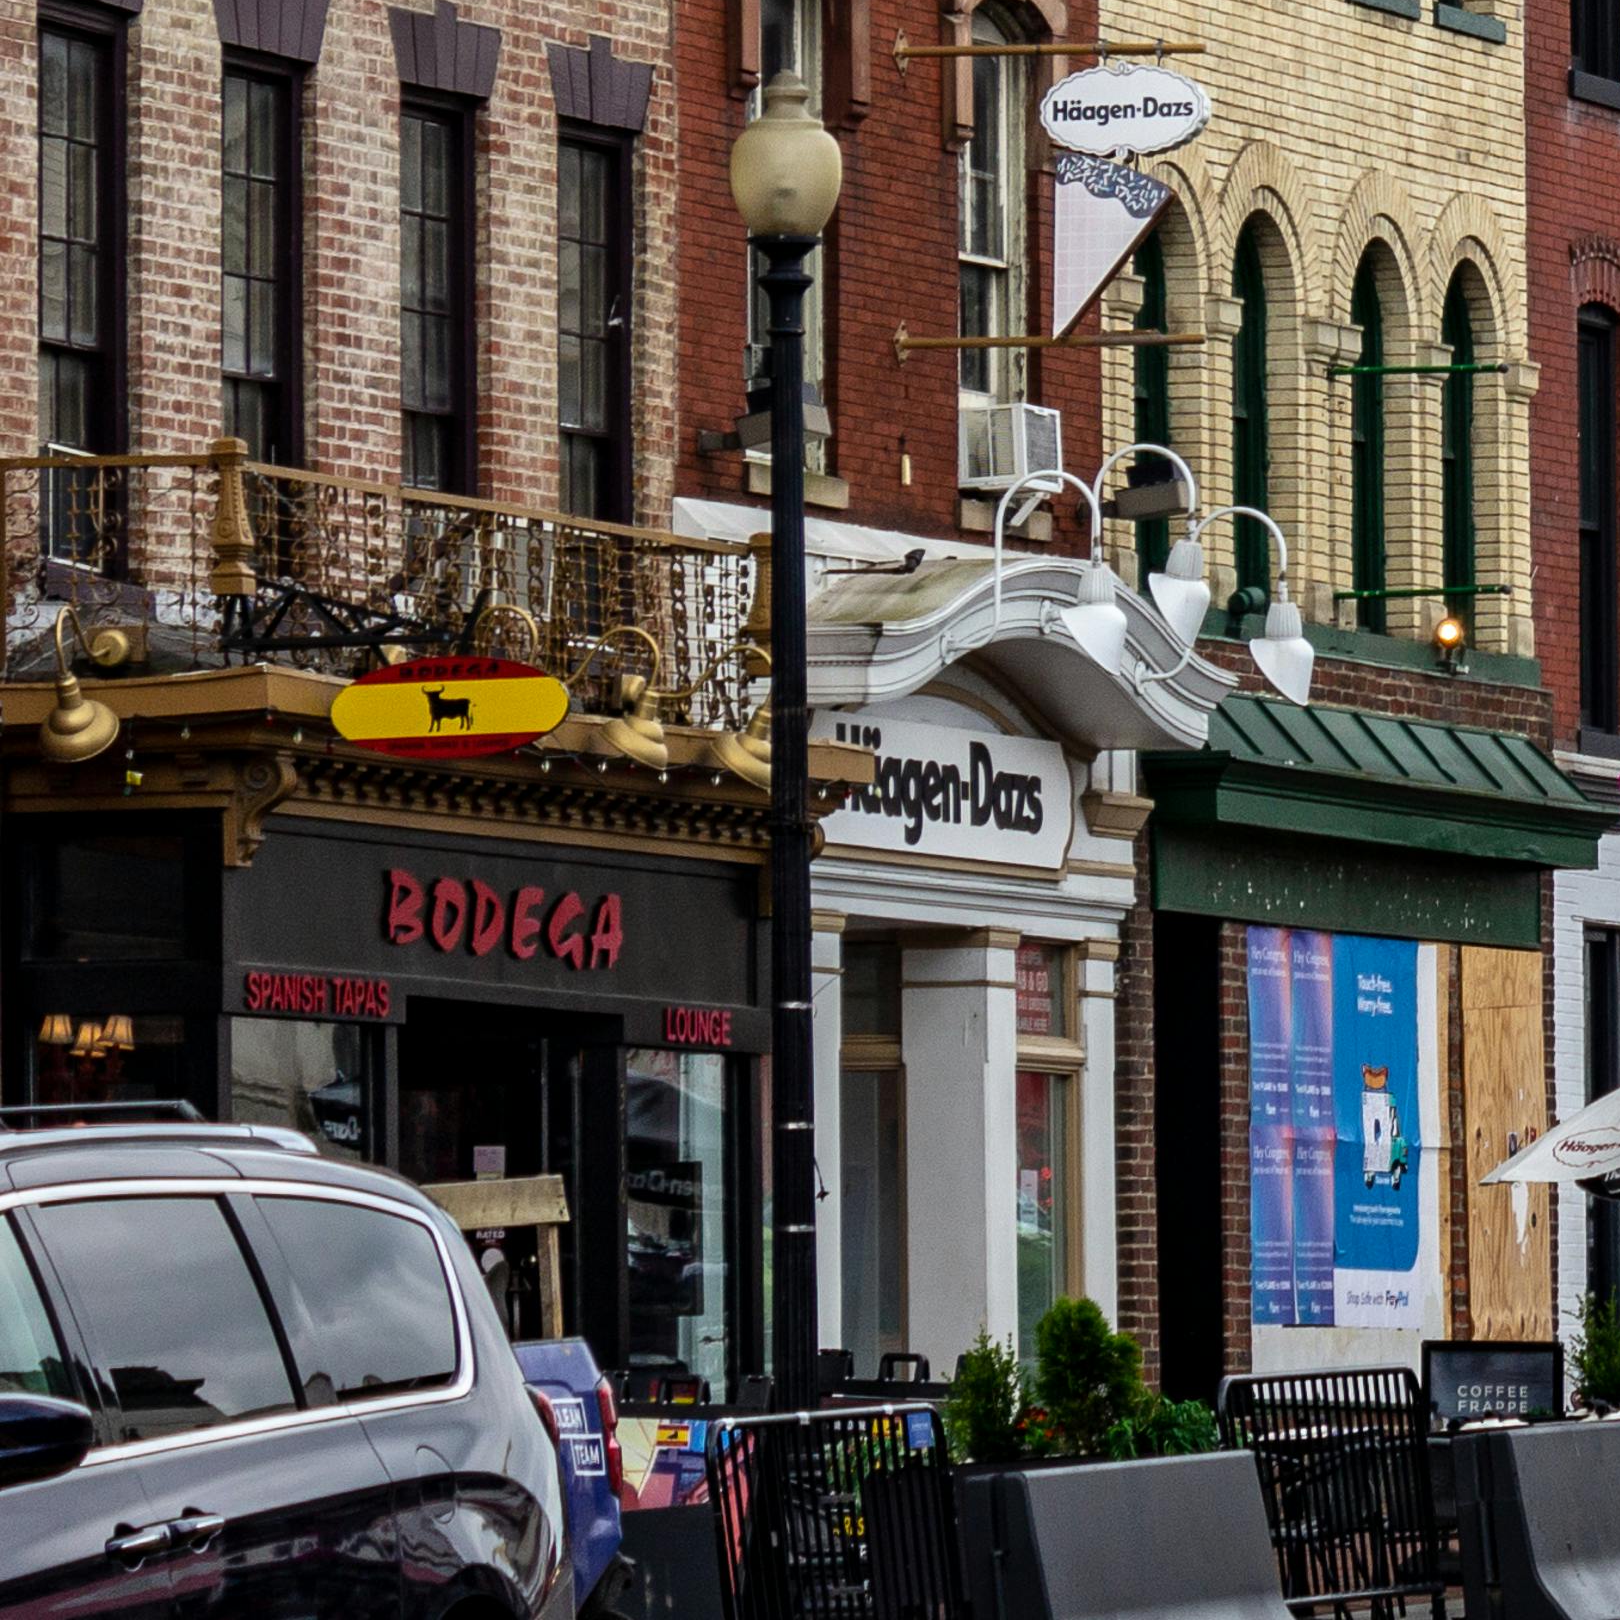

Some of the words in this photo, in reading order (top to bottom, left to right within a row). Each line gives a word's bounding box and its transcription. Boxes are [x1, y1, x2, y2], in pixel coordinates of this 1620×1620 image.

[385, 868, 623, 970] BODEGA
[246, 971, 327, 1014] SPANISH
[333, 976, 390, 1018] TAPAS
[665, 1007, 732, 1046] LOUNGE
[1385, 1291, 1409, 1310] PayPal
[1457, 1384, 1529, 1398] COFFEE
[1457, 1400, 1529, 1413] FRAPPE
[574, 1444, 601, 1465] TEAM
